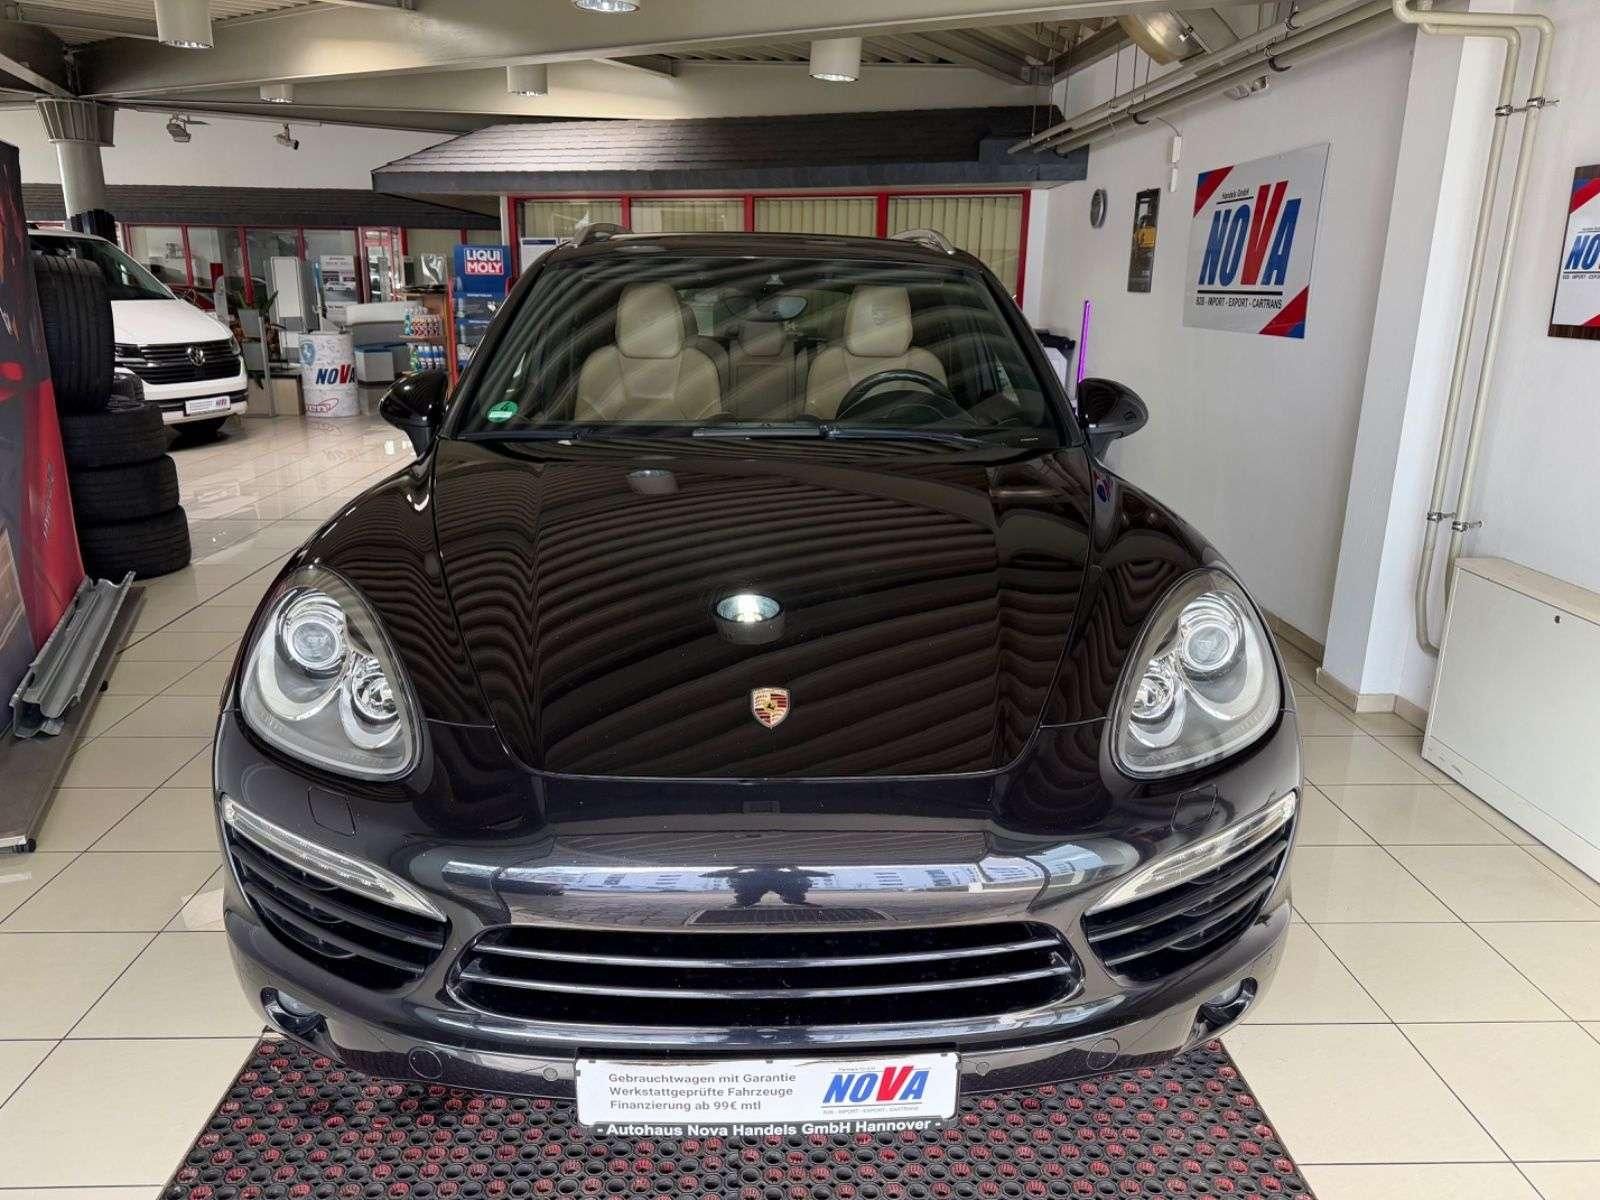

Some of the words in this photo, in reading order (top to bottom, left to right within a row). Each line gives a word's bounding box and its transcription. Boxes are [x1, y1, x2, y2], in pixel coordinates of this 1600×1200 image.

[1198, 180, 1302, 286] NOVA
[466, 249, 501, 261] LIQUI
[1564, 234, 1600, 270] NO
[466, 261, 502, 273] MOLY
[315, 364, 357, 385] NOVA
[608, 1073, 715, 1085] Gebrauchtwagen
[718, 1074, 739, 1083] mit
[743, 1072, 796, 1083] Garantie
[822, 1065, 930, 1104] NOVA
[609, 1086, 724, 1098] Werkstattgeprüfte
[727, 1086, 793, 1098] Fahrzeuge
[610, 1100, 691, 1112] Finanzierung
[695, 1100, 710, 1110] ab
[713, 1101, 737, 1111] 99€
[740, 1100, 761, 1110] mtl
[606, 1124, 683, 1136] Autohaus
[687, 1124, 728, 1136] Nova
[733, 1123, 797, 1136] Handels
[801, 1122, 851, 1135] GmbH
[855, 1119, 930, 1133] Hannover
